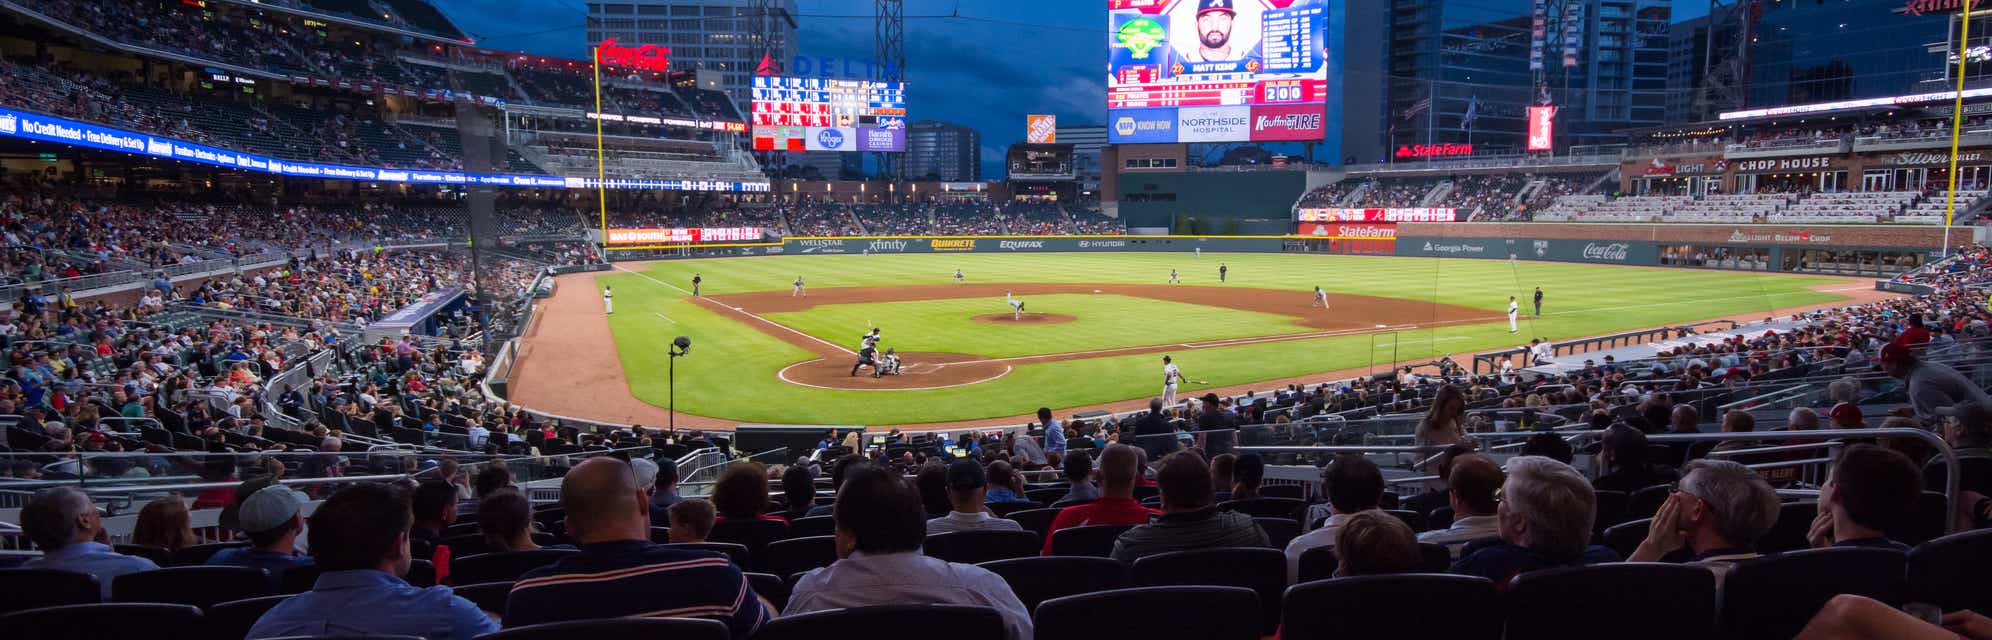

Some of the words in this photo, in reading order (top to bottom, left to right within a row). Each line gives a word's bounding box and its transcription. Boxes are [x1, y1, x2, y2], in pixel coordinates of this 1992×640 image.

[793, 55, 900, 80] DELTA
[1193, 64, 1213, 72] MATT
[1215, 63, 1237, 71] KEMP
[1267, 88, 1276, 99] 2
[1279, 88, 1288, 99] 0
[1292, 88, 1300, 99] 0
[1137, 121, 1153, 131] KNOW
[1156, 119, 1171, 130] HOW
[1182, 117, 1247, 127] NORTHSIDE
[1255, 115, 1296, 131] Kauffman
[1287, 113, 1320, 131] TIRE
[22, 119, 34, 133] No
[34, 121, 56, 136] Credit
[56, 125, 81, 140] Needed
[87, 130, 100, 142] Free
[100, 132, 123, 148] Delivery
[819, 131, 842, 148] Kroger
[1739, 159, 1776, 171] CHOP
[1781, 157, 1830, 169] HOUSE
[1897, 152, 1949, 165] Silver
[1951, 153, 1981, 162] ULLET
[1675, 163, 1705, 174] LIGHT
[609, 232, 629, 241] GAS
[636, 231, 664, 241] SOUTH
[800, 239, 843, 248] WELLSTAR
[869, 238, 908, 252] xfinity
[931, 239, 976, 248] QUIKRETE
[1000, 240, 1044, 250] EQUIFAX
[1434, 244, 1461, 253] Georgia
[1463, 244, 1484, 252] Power
[1771, 468, 1795, 479] ALERT
